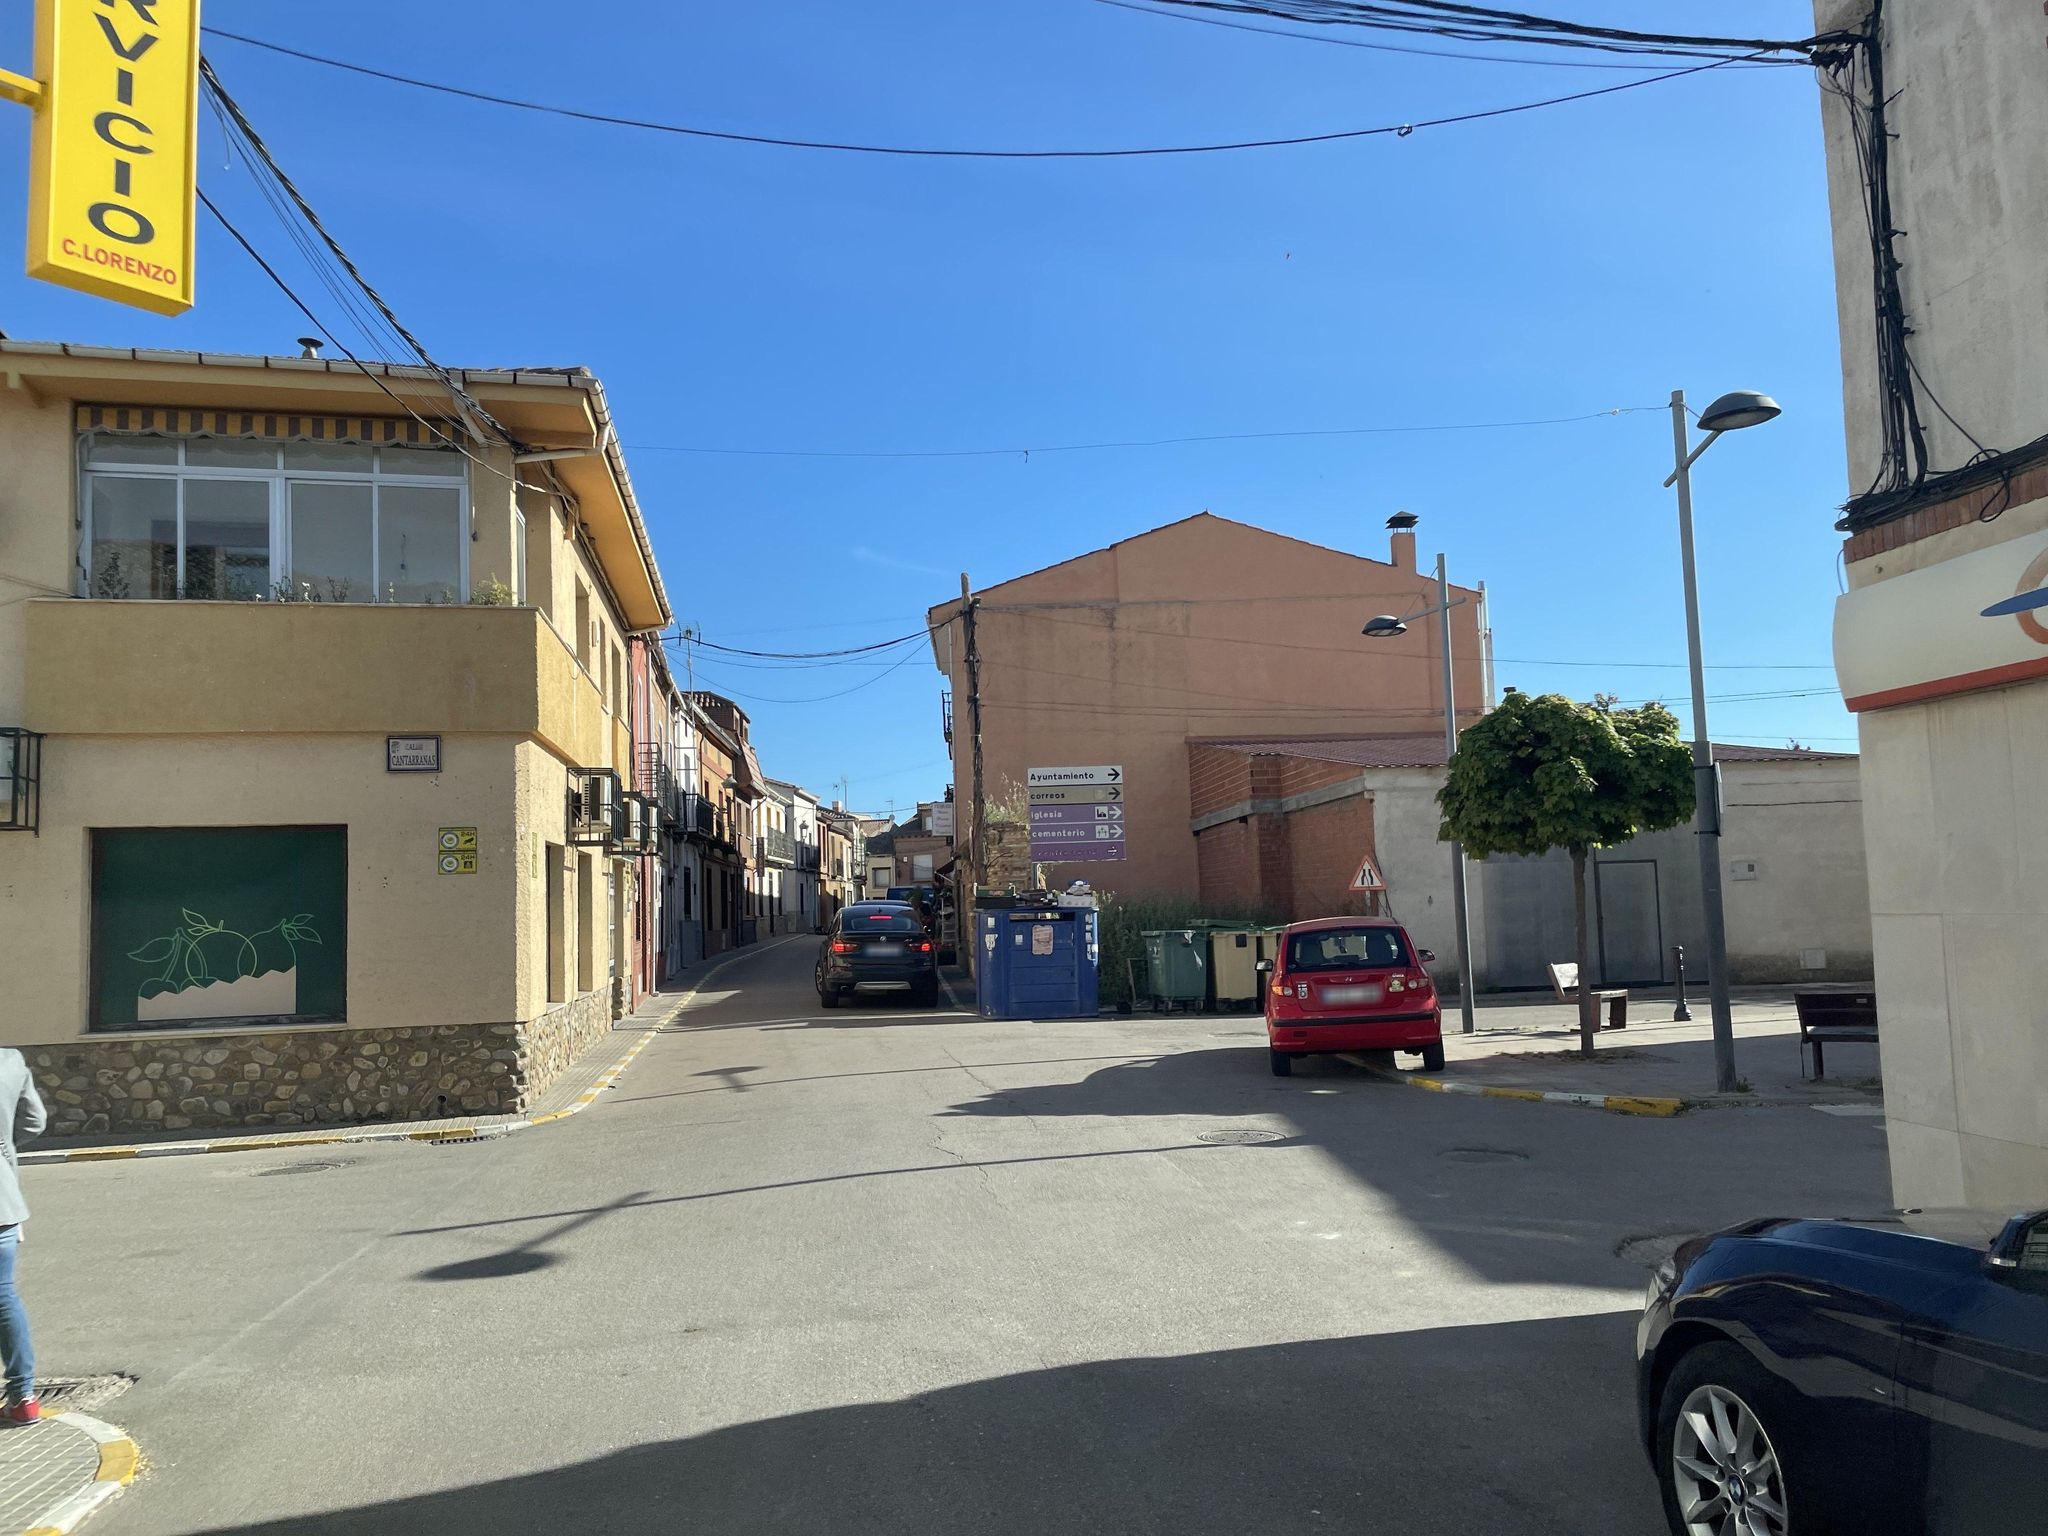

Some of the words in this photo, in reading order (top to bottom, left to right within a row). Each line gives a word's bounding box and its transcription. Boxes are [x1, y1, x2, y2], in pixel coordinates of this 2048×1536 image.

[62, 238, 177, 285] C.LORENZO
[391, 755, 436, 766] CANTARRANAS
[1030, 772, 1094, 782] Ayuntamiento
[1031, 810, 1062, 819] iglesia
[1032, 829, 1085, 837] cementerio
